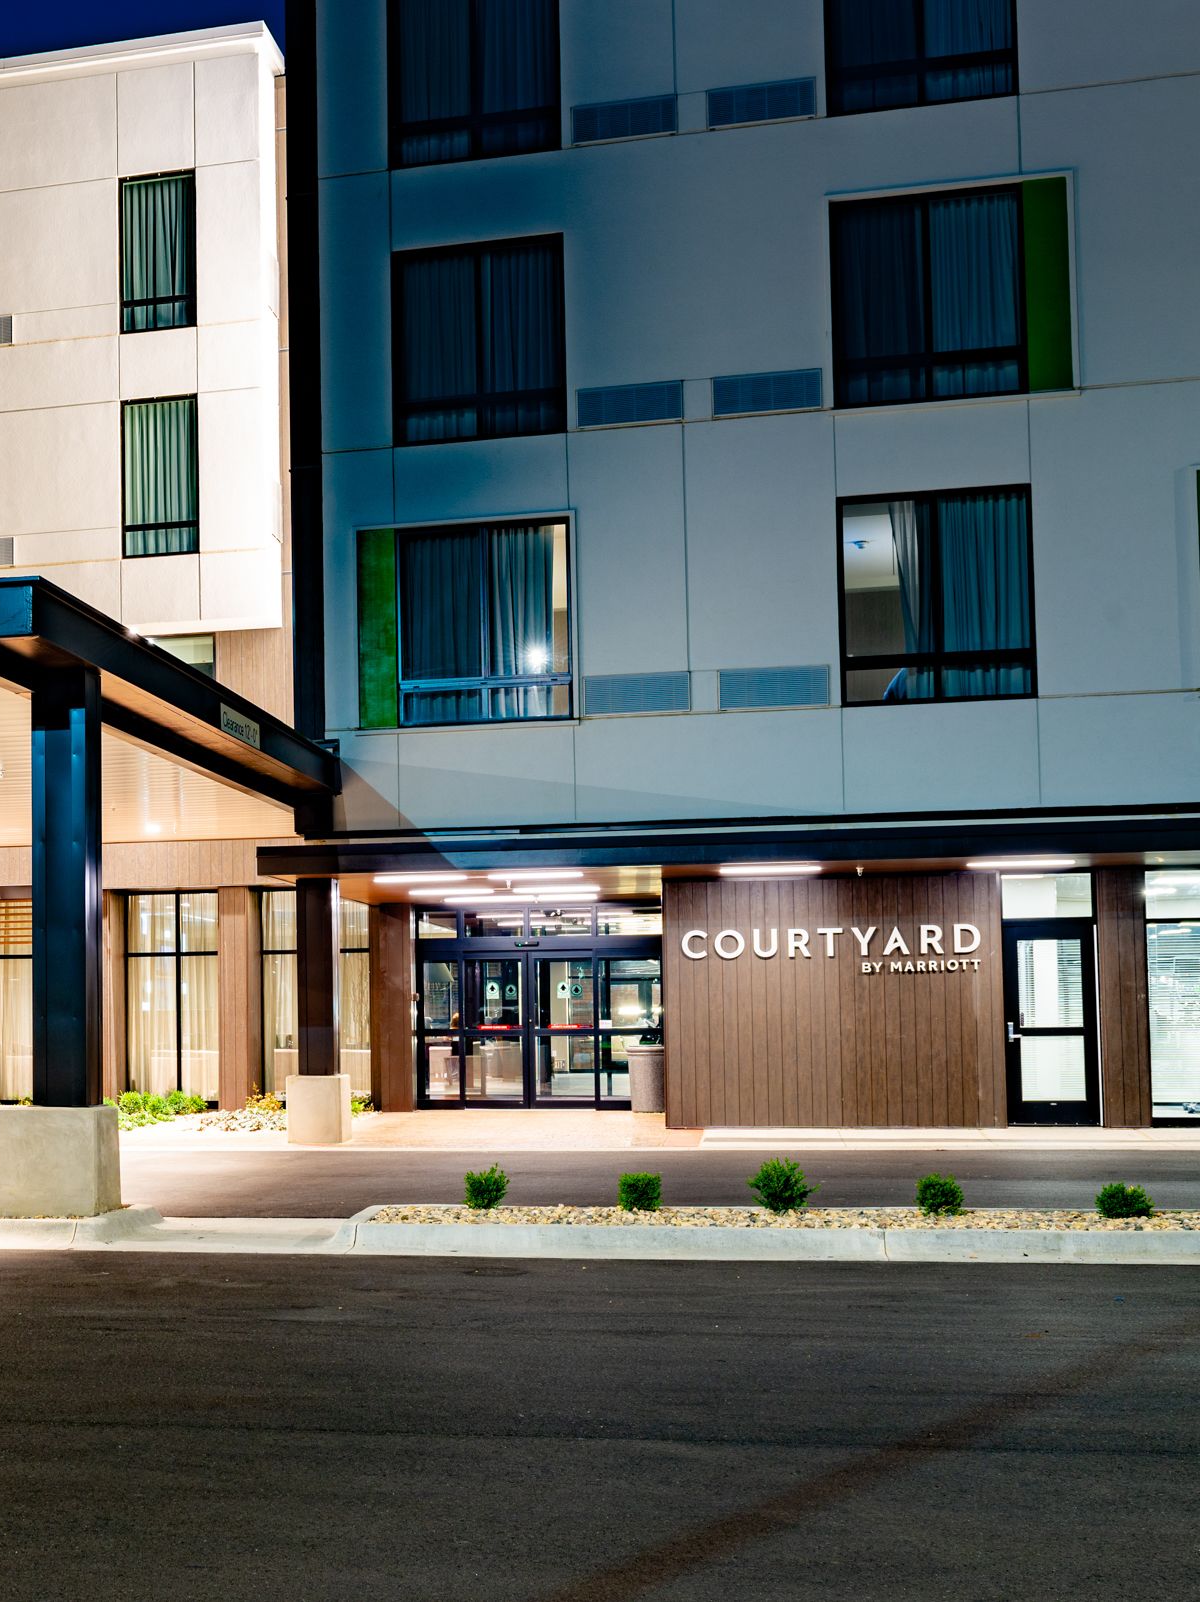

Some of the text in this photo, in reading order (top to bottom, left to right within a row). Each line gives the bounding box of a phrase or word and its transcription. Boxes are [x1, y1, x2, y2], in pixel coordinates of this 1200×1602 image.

[680, 923, 982, 960] COURTYARD
[861, 959, 982, 974] BY MARRIOTT
